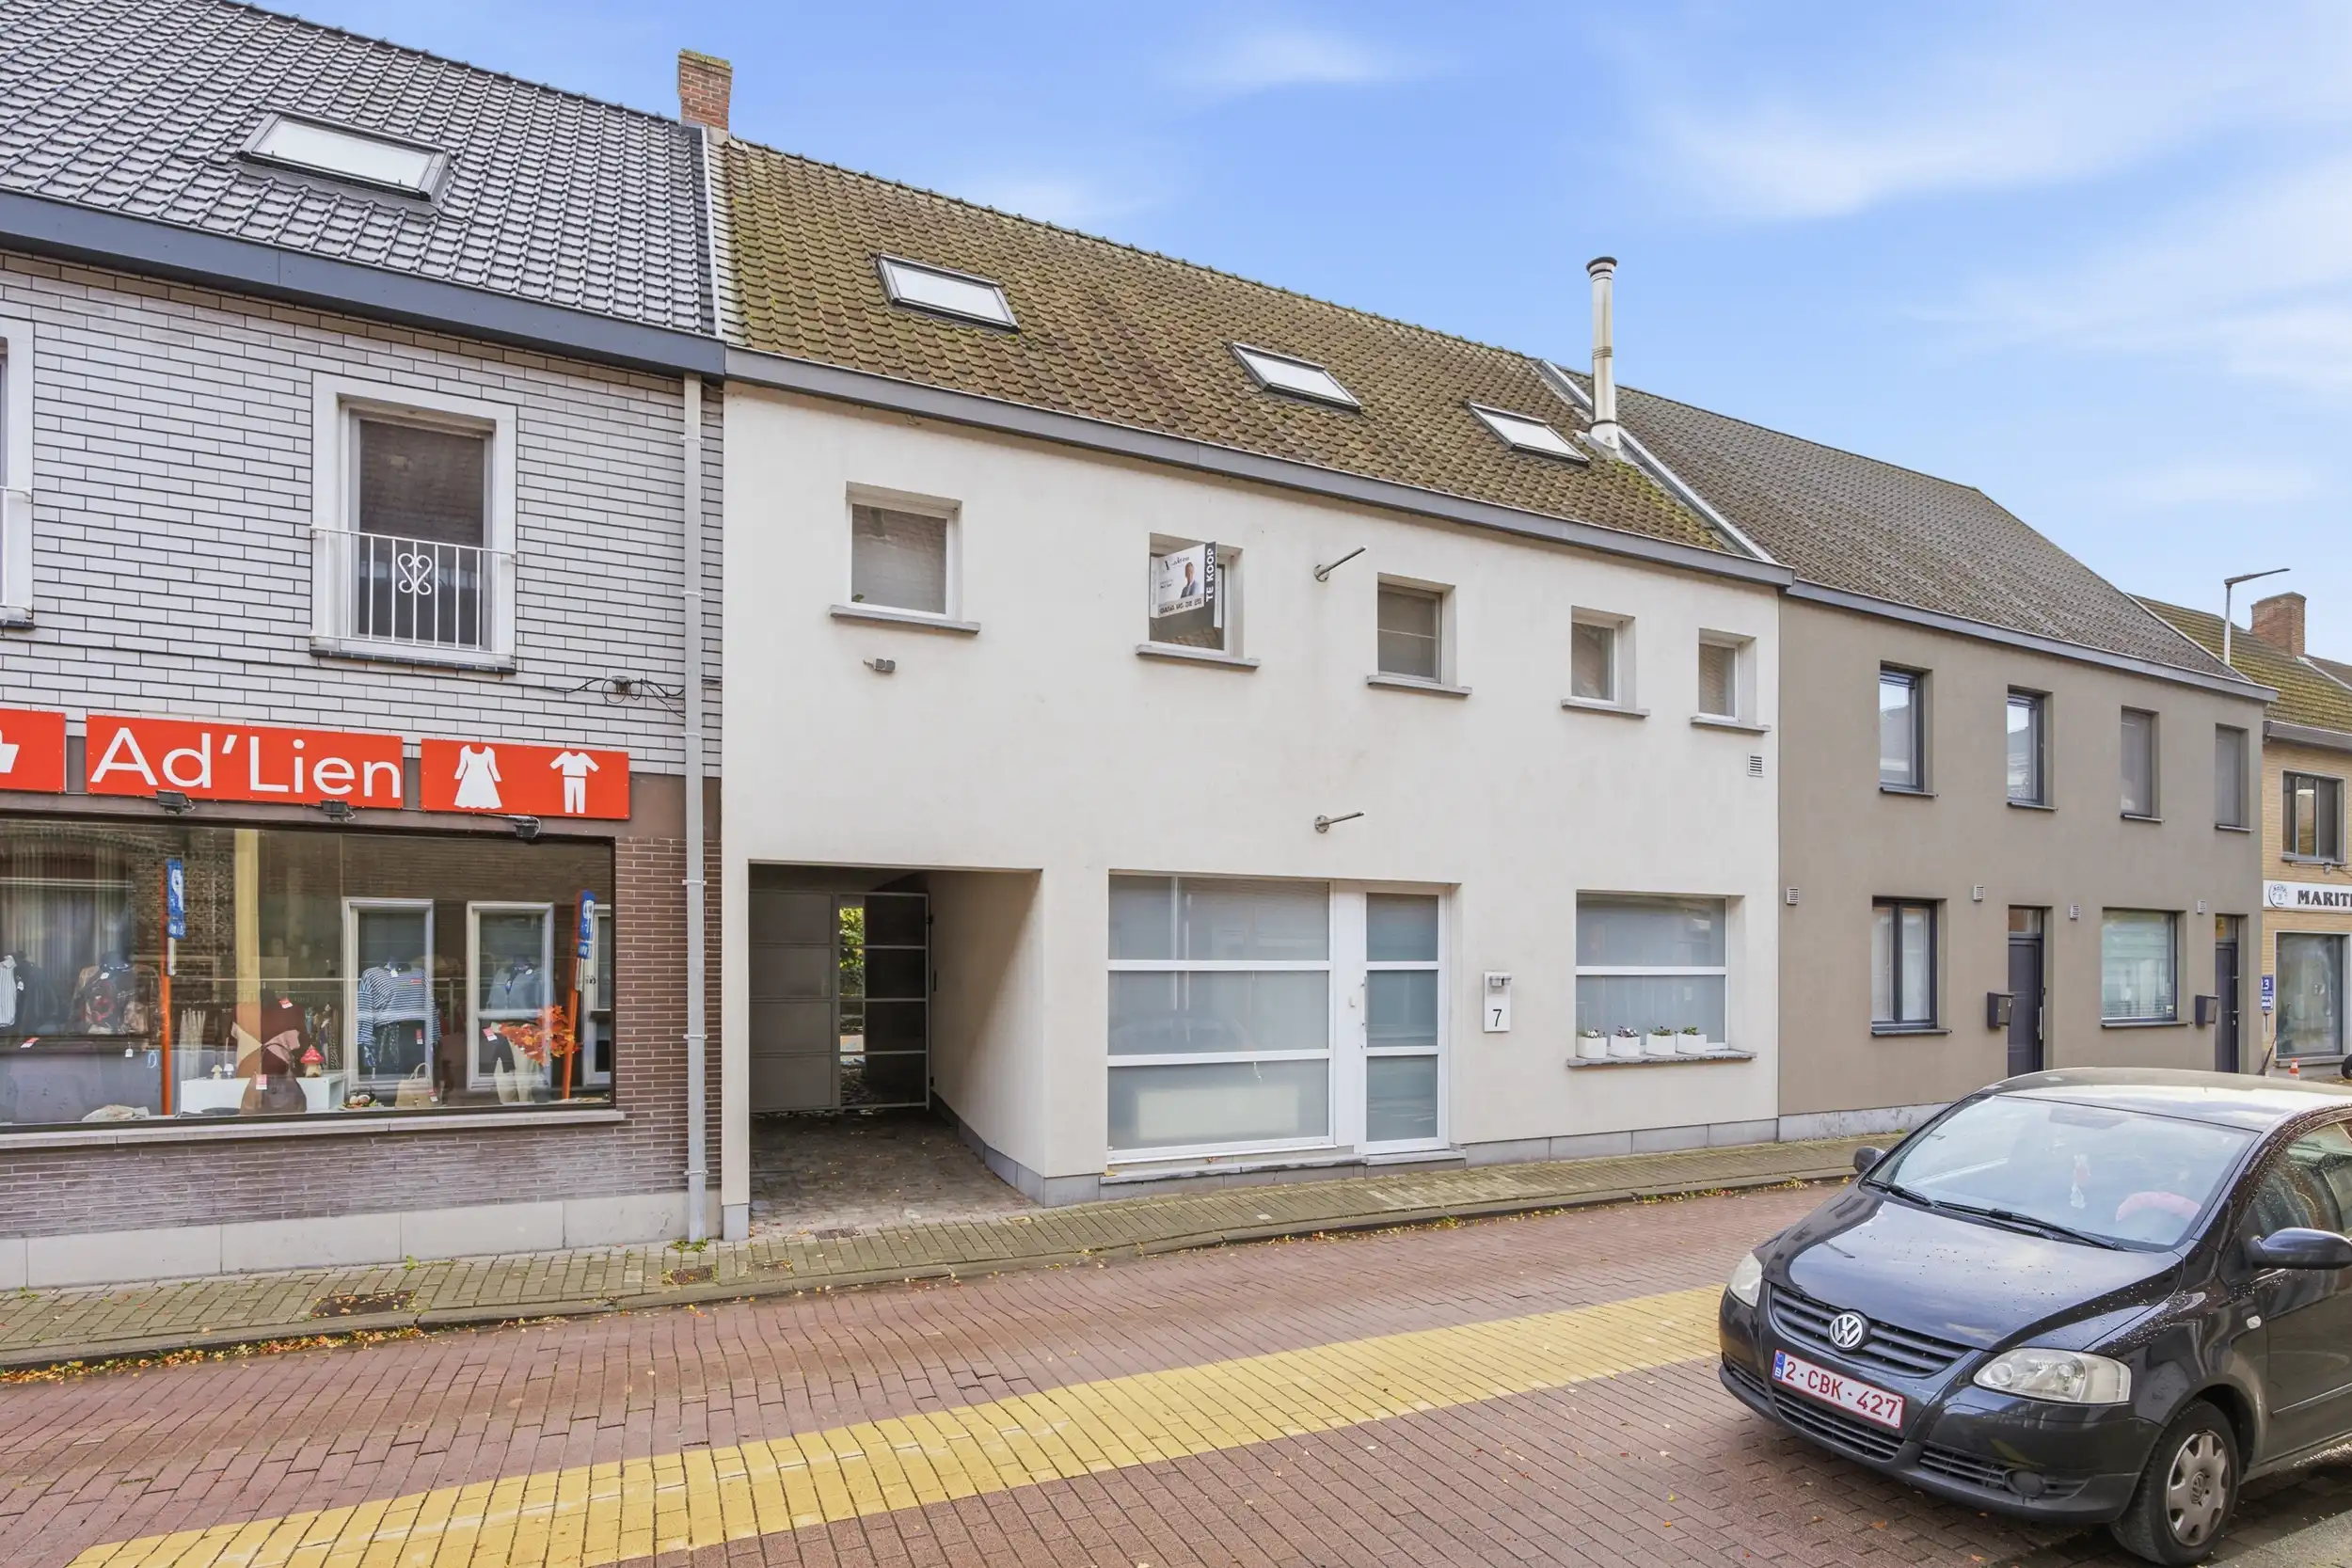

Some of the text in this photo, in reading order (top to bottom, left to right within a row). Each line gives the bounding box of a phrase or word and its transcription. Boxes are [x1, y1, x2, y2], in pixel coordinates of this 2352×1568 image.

[1206, 548, 1215, 602] TE KOOP
[89, 726, 402, 799] Ad'Lien
[1492, 1008, 1502, 1027] 7
[1785, 1361, 1899, 1419] 2-CBK-427
